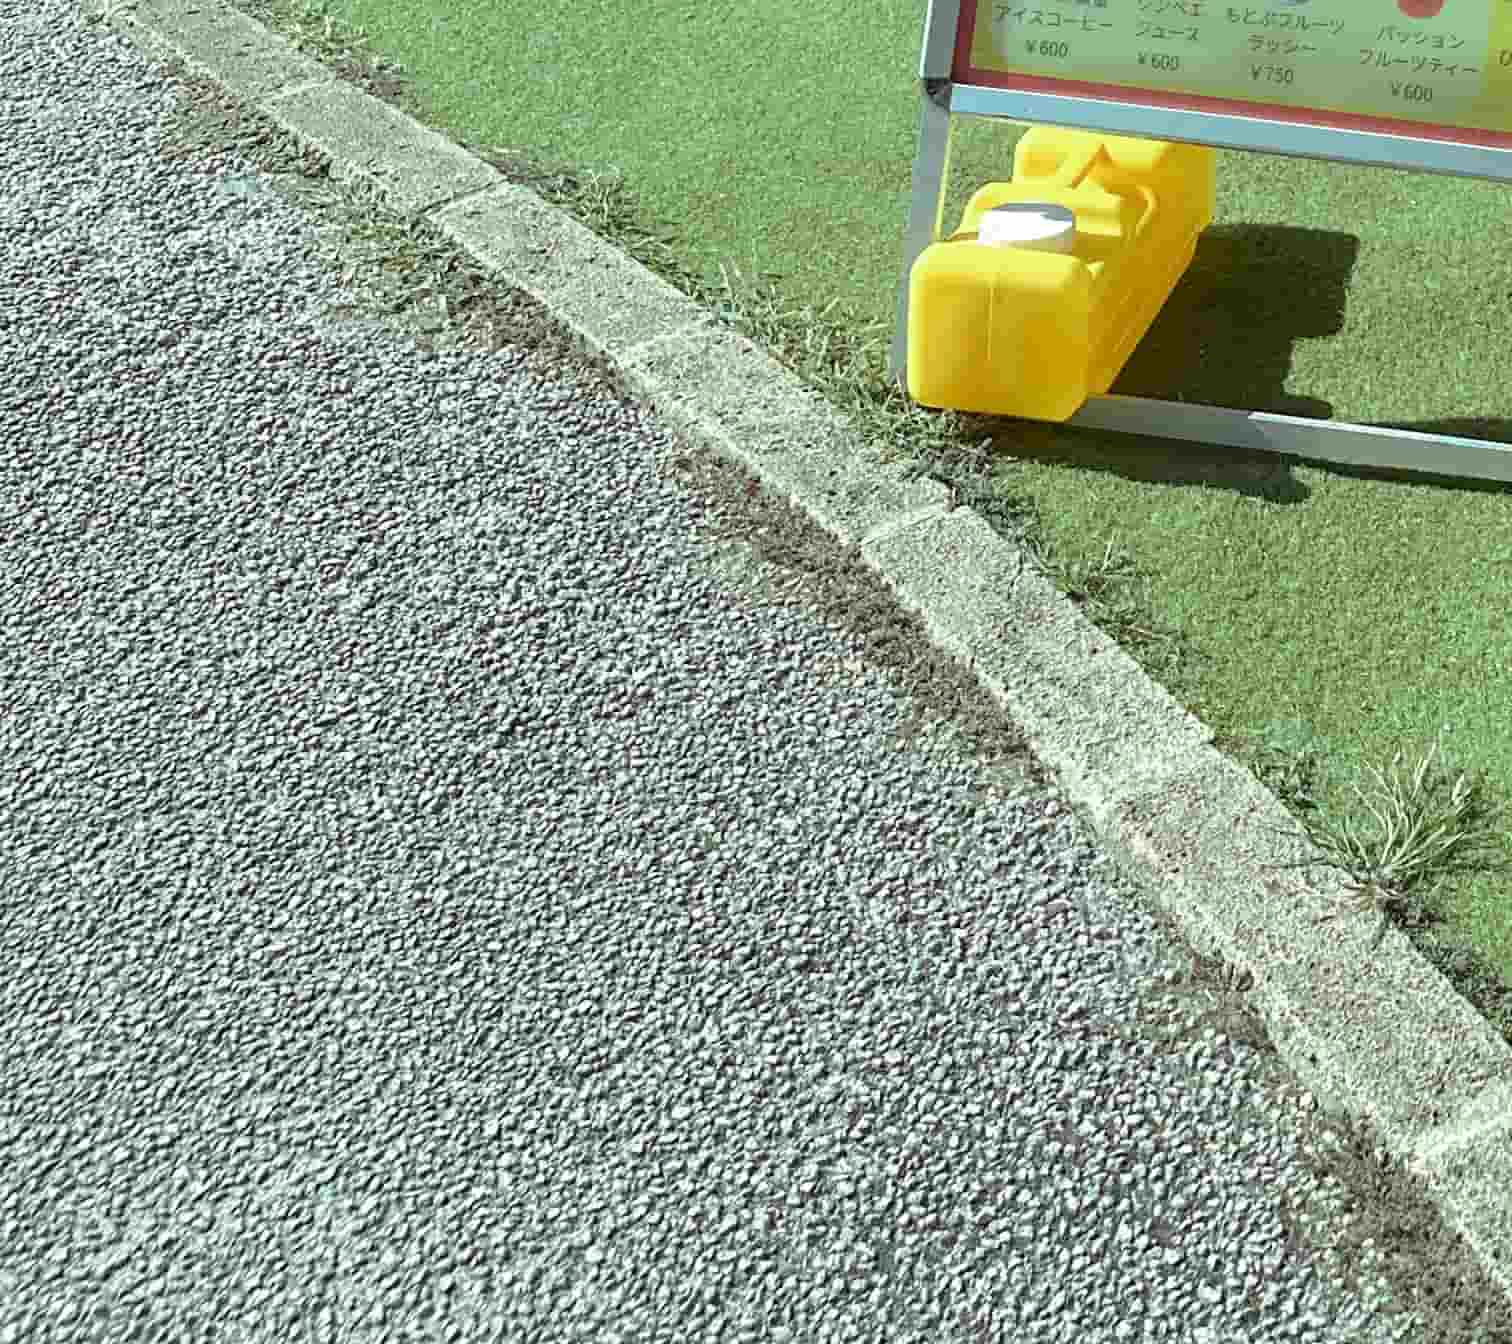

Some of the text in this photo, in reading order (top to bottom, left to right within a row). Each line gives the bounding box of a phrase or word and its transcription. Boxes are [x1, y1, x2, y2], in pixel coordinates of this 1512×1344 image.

[993, 3, 1113, 32] アイスコーヒー
[1248, 34, 1318, 55] ラッシー
[1375, 23, 1465, 50] パッション
[1025, 39, 1069, 59] ¥600
[1138, 52, 1180, 72] ¥600
[1359, 47, 1479, 77] フルーツティー
[1250, 65, 1295, 86] ¥750
[1391, 82, 1434, 103] ¥600
